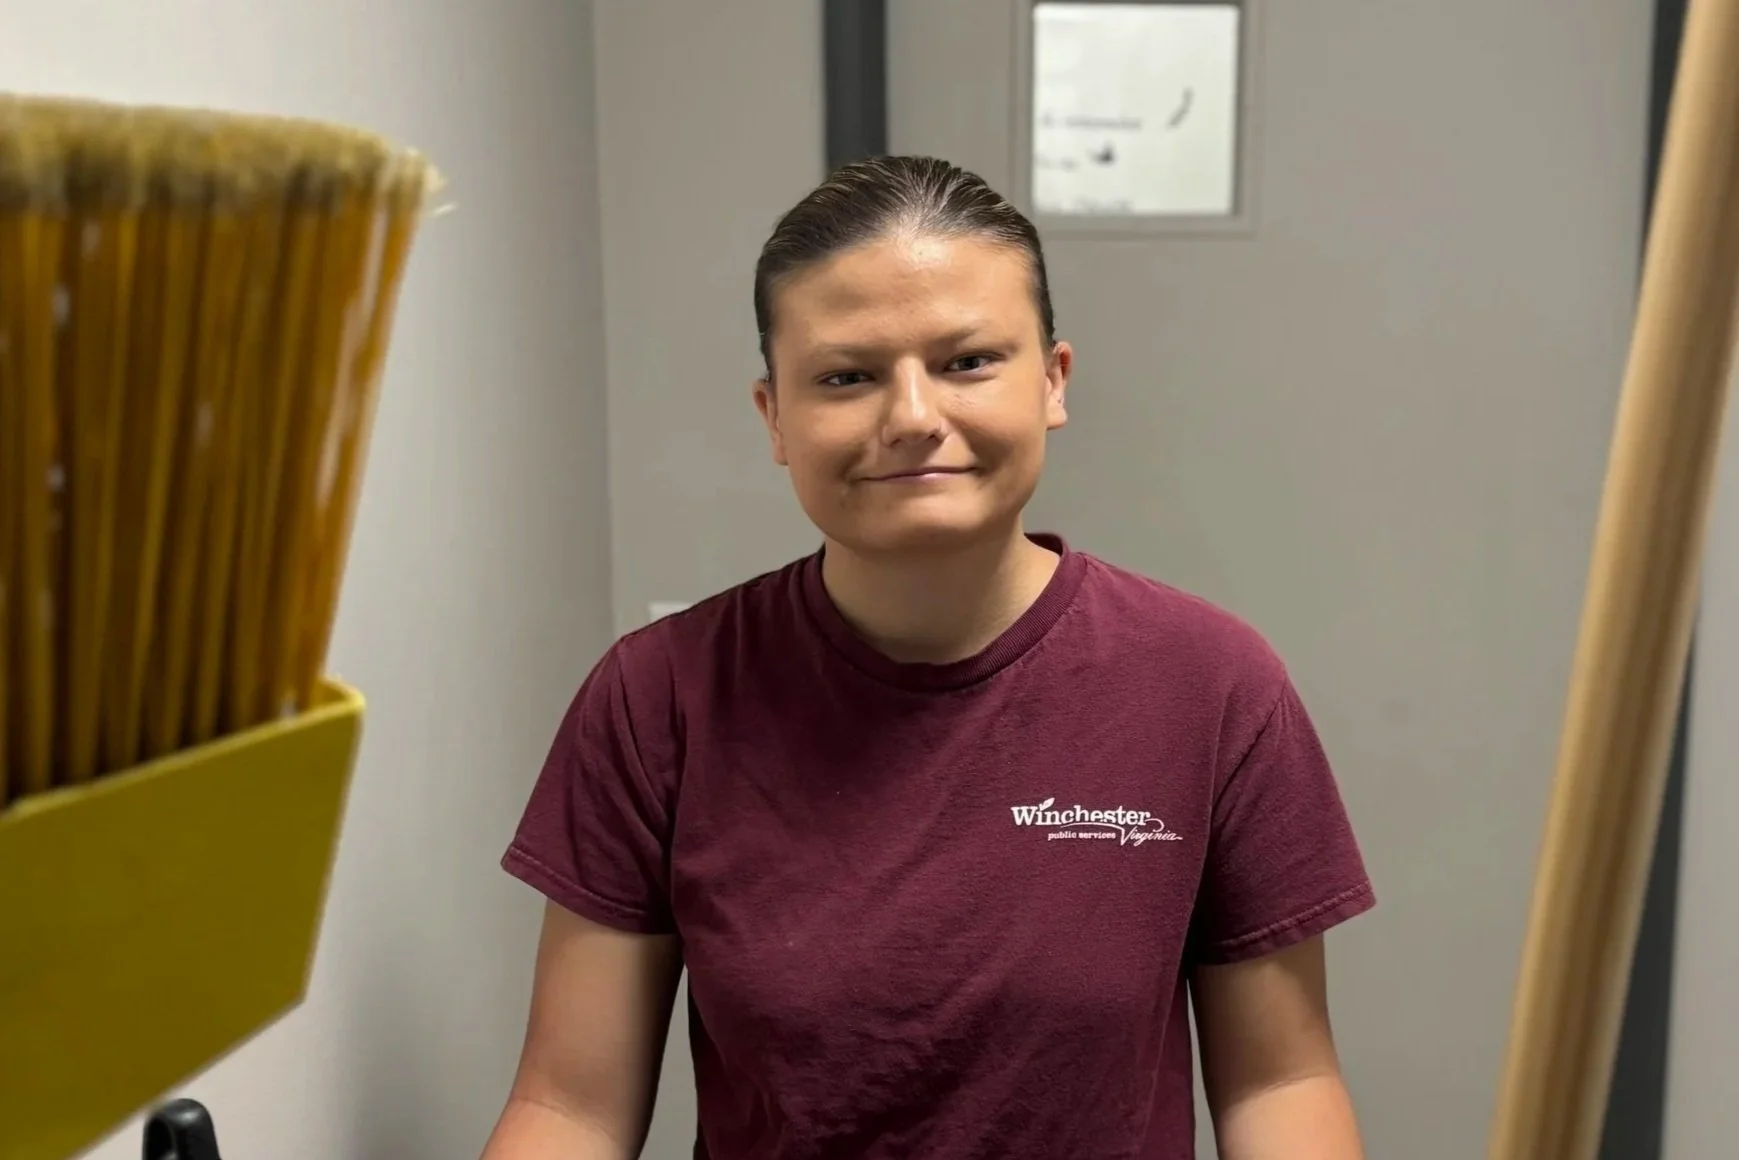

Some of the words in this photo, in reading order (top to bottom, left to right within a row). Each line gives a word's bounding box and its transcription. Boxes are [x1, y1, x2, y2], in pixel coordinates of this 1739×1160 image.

[1011, 799, 1151, 826] Winchester
[1047, 831, 1077, 841] public
[1078, 831, 1116, 839] services
[1120, 826, 1183, 847] Virginia
